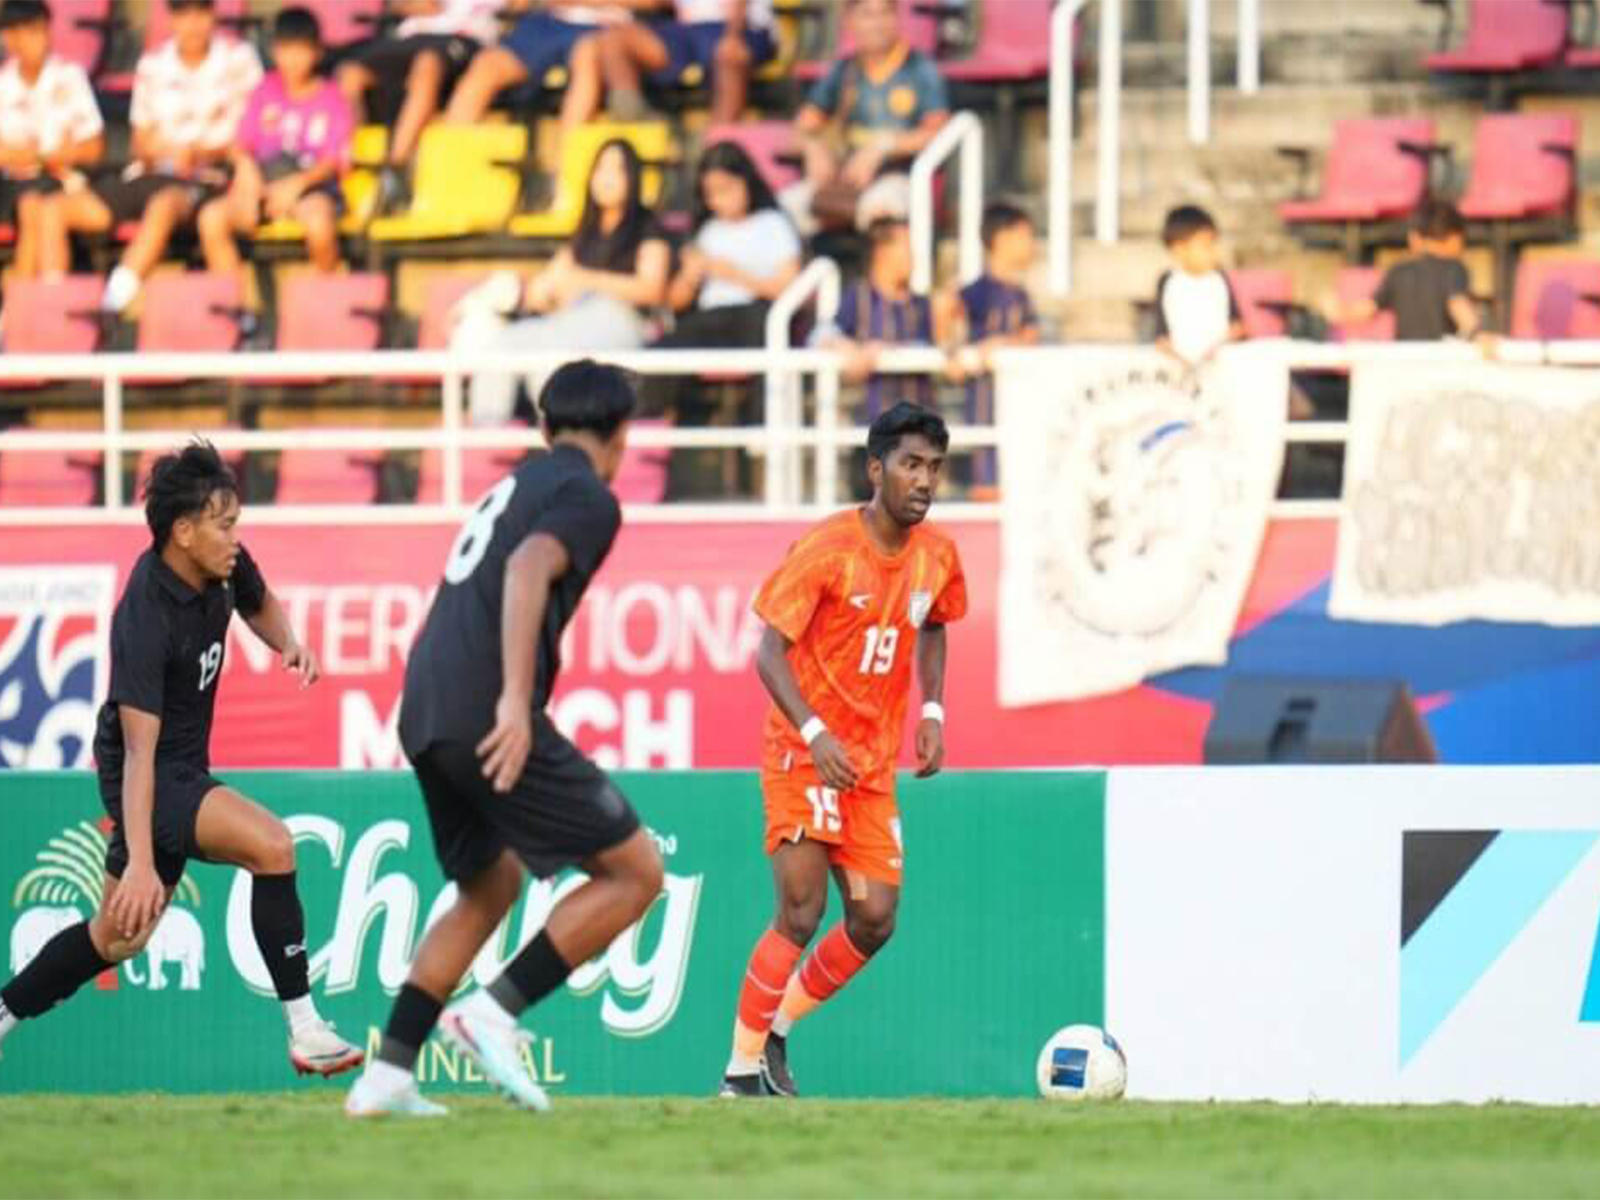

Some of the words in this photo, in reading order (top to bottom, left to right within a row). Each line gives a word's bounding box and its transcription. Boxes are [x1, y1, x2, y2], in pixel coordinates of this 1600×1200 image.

[445, 474, 517, 585] 8
[199, 642, 222, 691] 19
[858, 625, 899, 675] 19
[338, 688, 694, 769] MCH
[363, 1025, 567, 1083] INAL
